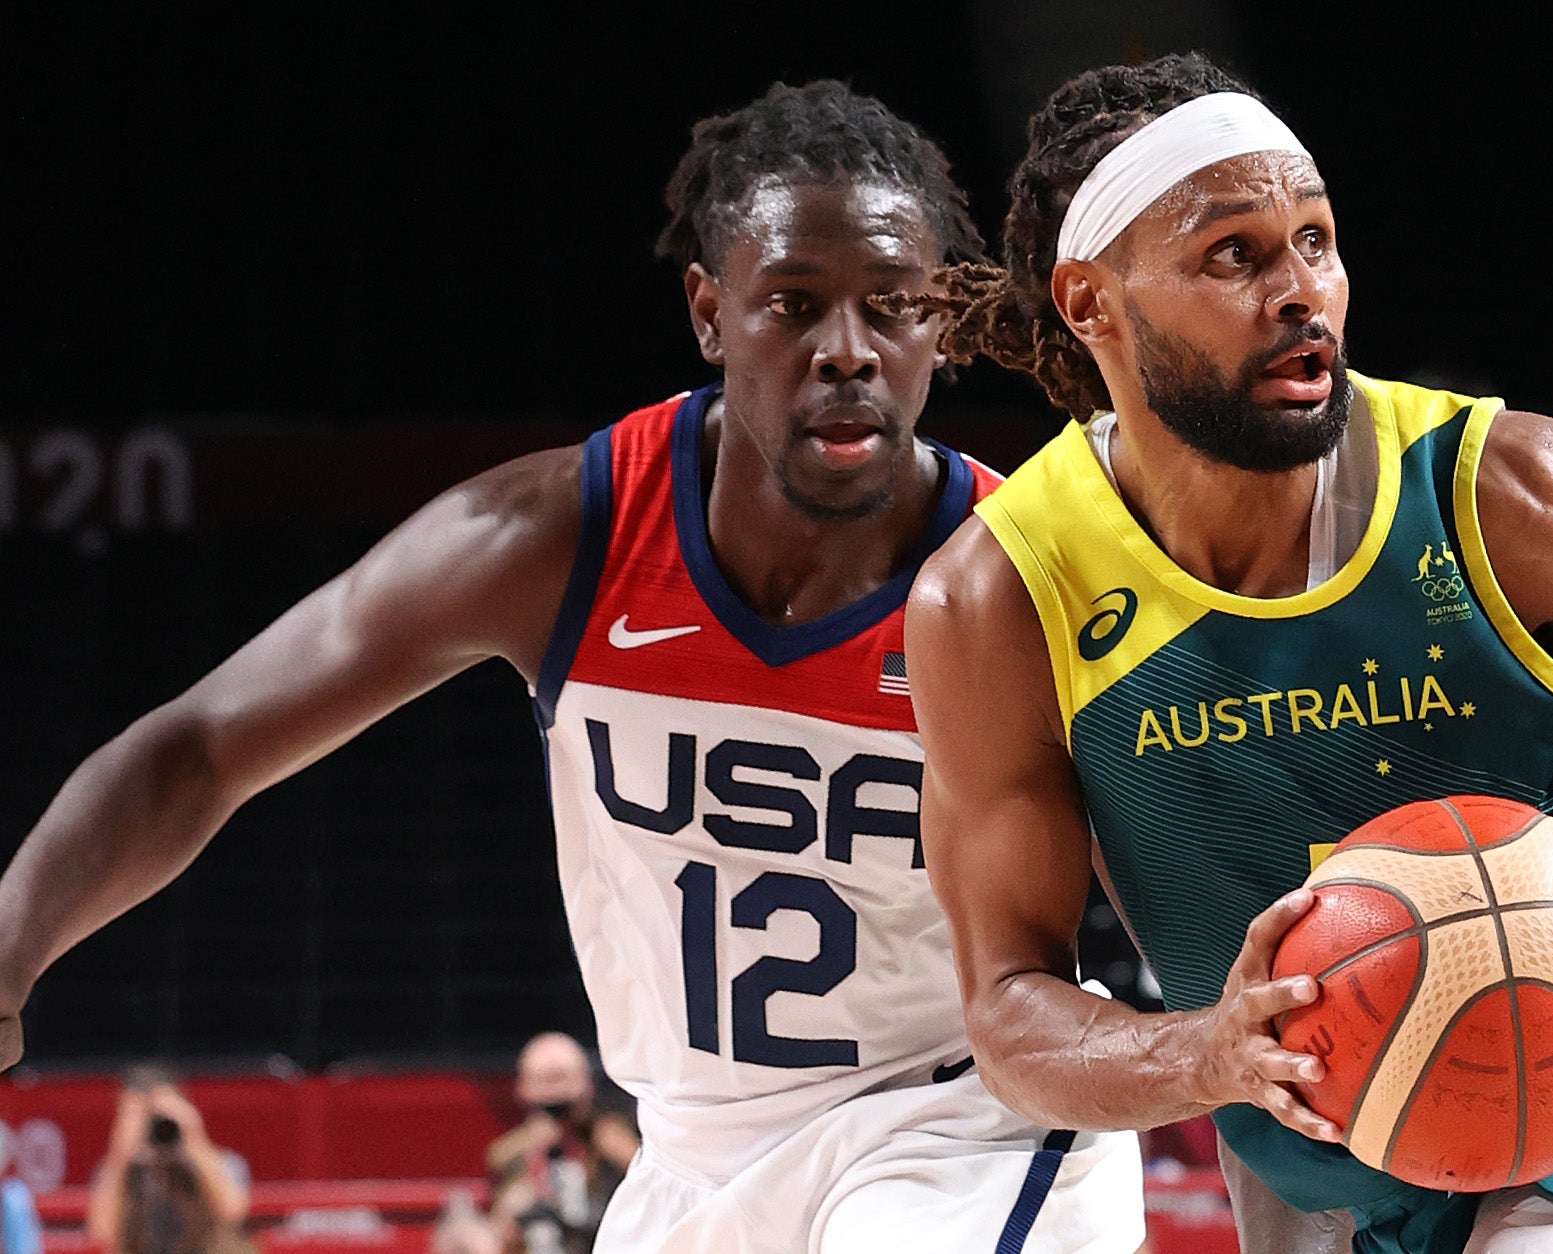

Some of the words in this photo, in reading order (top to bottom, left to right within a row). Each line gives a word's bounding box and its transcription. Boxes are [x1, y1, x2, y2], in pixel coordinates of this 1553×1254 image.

[1426, 601, 1470, 616] AUSTRALIA
[1135, 675, 1456, 757] AUSTRALIA
[585, 717, 927, 869] USA
[674, 860, 859, 1070] 12
